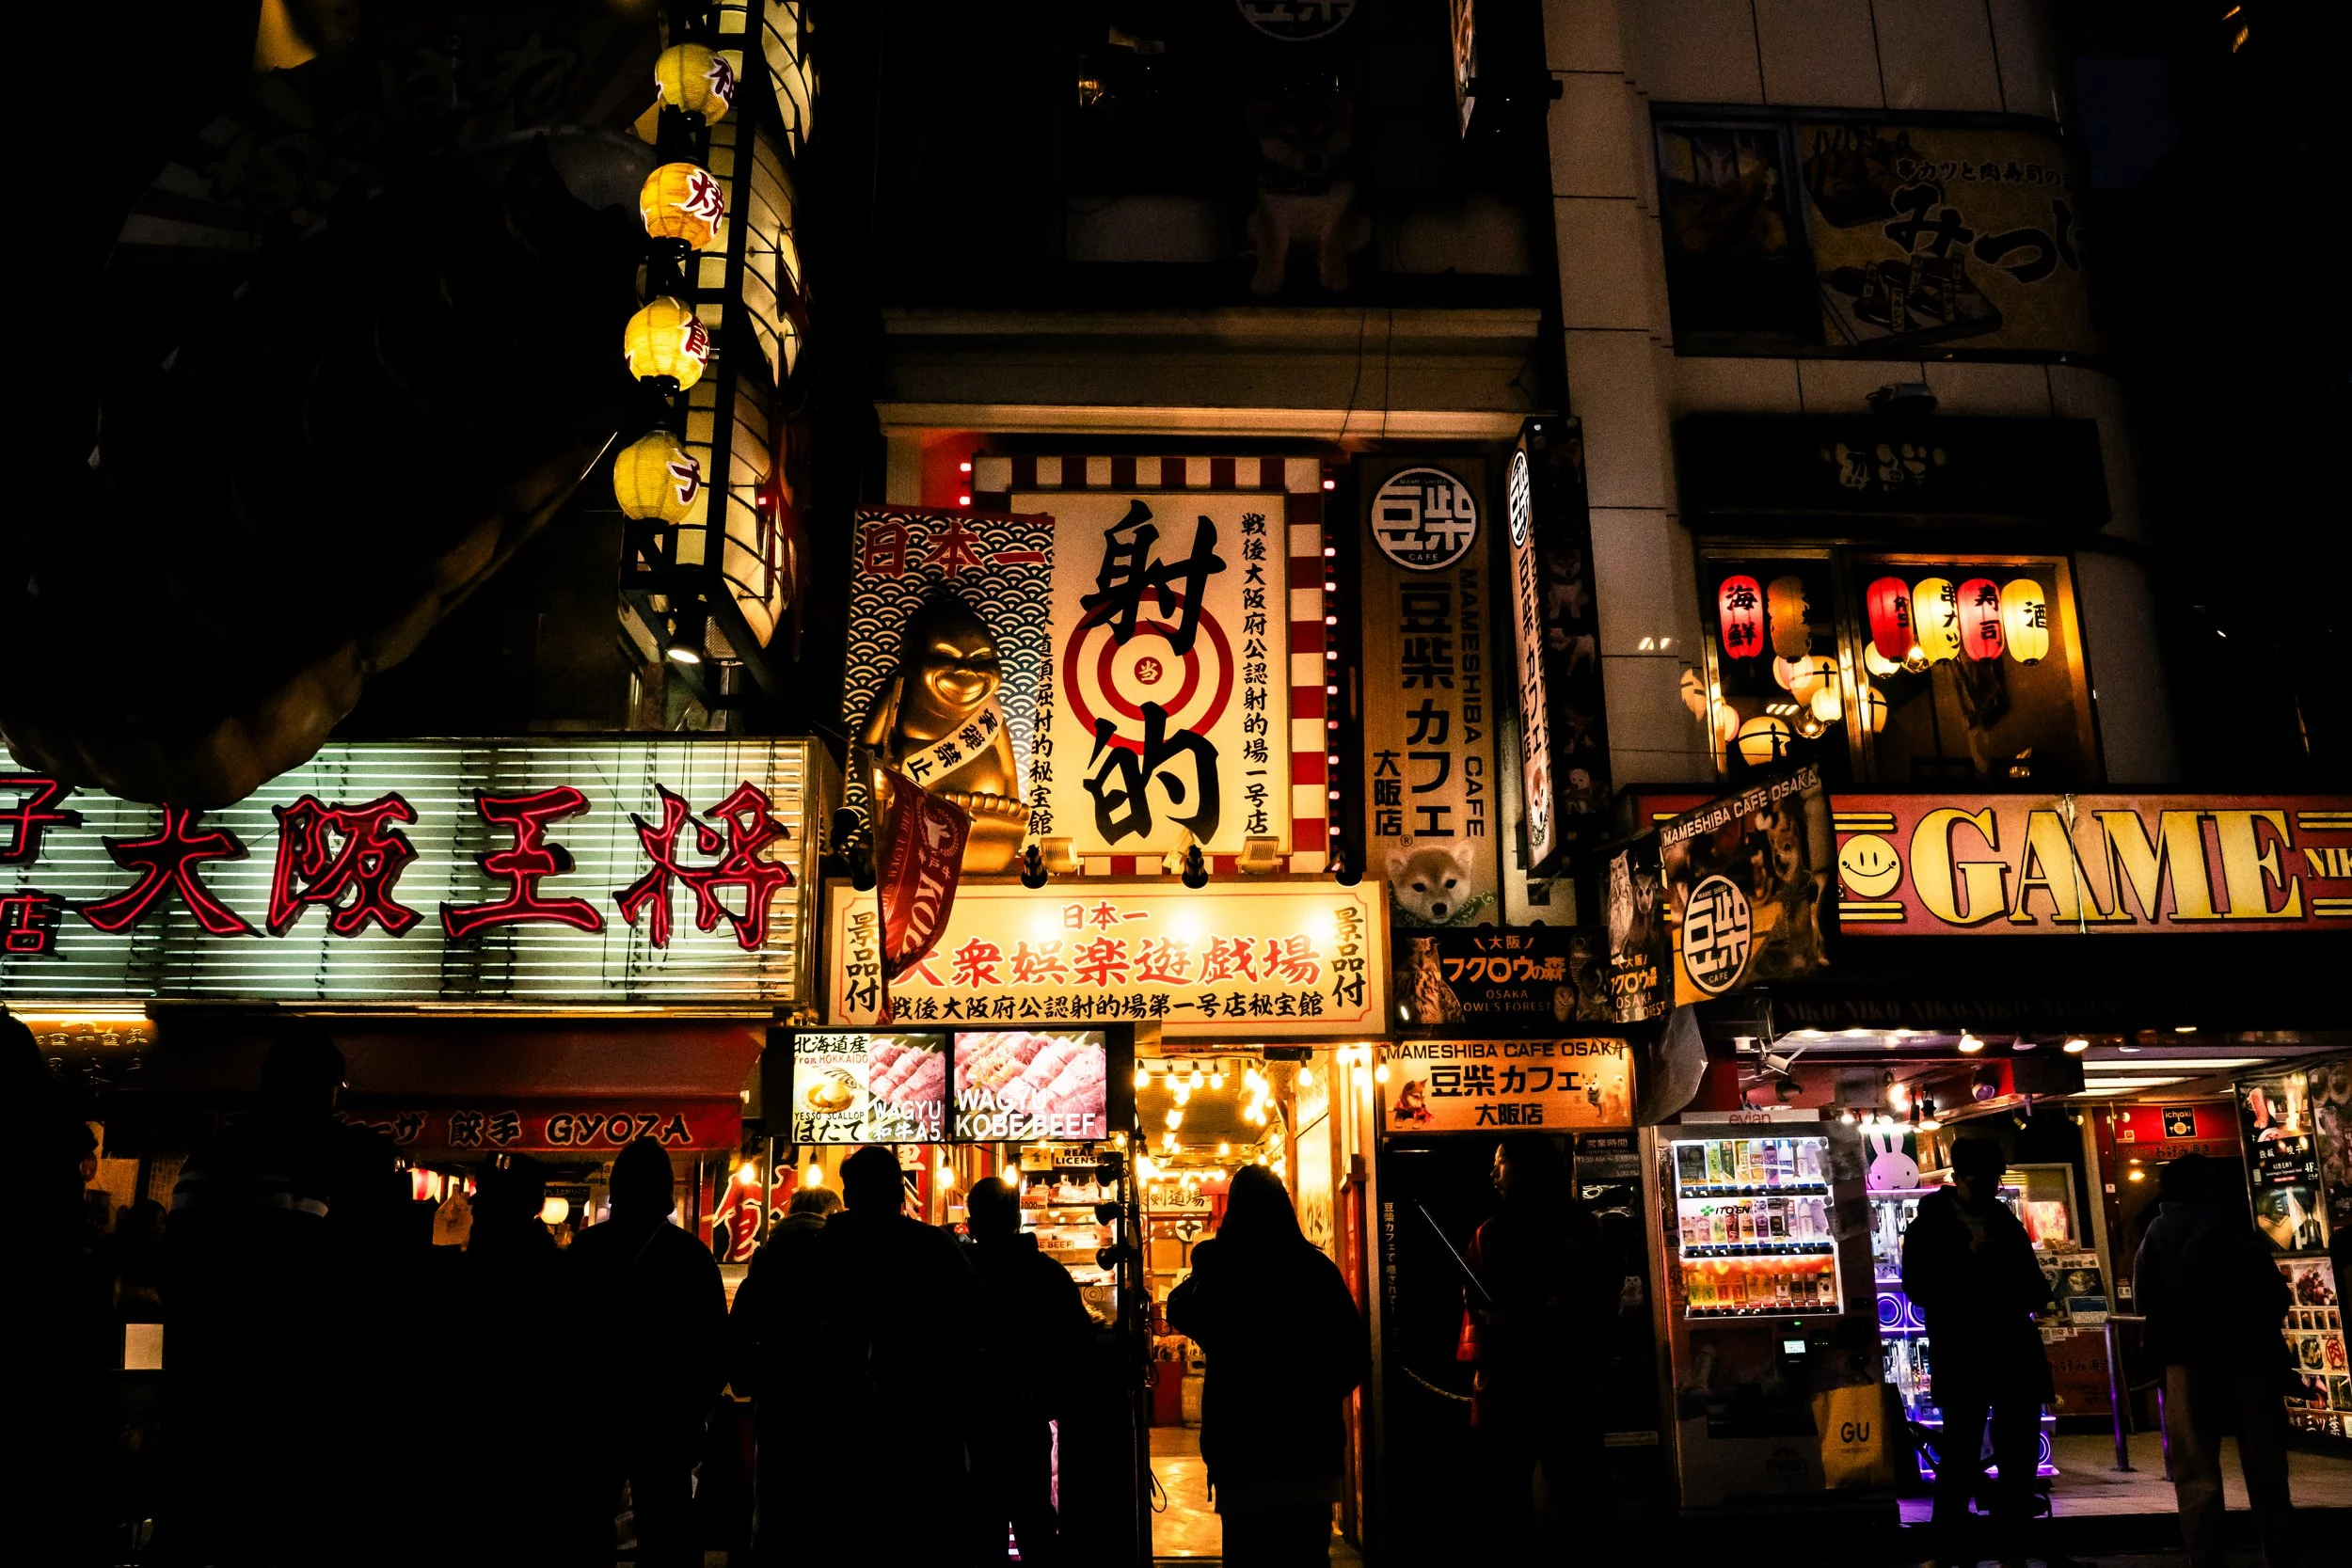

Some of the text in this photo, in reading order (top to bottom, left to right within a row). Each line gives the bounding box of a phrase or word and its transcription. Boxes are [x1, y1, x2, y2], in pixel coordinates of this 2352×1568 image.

[1884, 182, 2079, 282] みつ
[1377, 483, 1474, 552] 豆柴
[862, 522, 1047, 579] 日本一
[1408, 553, 1438, 562] CAFE
[1725, 584, 1758, 649] 海鮮
[1975, 582, 2002, 647] 寿司
[2023, 601, 2047, 628] 酒
[1079, 499, 1227, 846] 射的
[1137, 658, 1160, 684] 当
[1240, 513, 1270, 835] 戦後大阪府公認射的場一号店
[1459, 568, 1486, 838] MAMESHIBA CAFE
[905, 708, 999, 784] 実弾禁止
[1374, 749, 1403, 837] 大阪店
[1661, 768, 1818, 848] MAMESHIBA CAFE OSAKA
[68, 779, 798, 952] 大阪王将
[1910, 806, 2305, 927] GAME
[1062, 902, 1149, 931] 日本一
[1487, 935, 1521, 950] 大阪
[846, 911, 881, 1013] 景品付
[1330, 906, 1367, 1008] 景品付
[1442, 955, 1567, 984] フクロウの森
[1708, 972, 1729, 984] CAFE
[1486, 989, 1529, 1000] OSAKA
[1505, 1002, 1551, 1013] FOREST
[794, 1035, 868, 1054] 北海道産
[819, 1053, 869, 1064] HOKKAIDO
[1386, 1040, 1625, 1061] MAMESHIBA CAFE OSAKA
[873, 1100, 942, 1121] WAGYU
[956, 1086, 1048, 1112] WAGYU
[794, 1110, 866, 1121] YESSO SCALLOP
[956, 1112, 1097, 1137] KOBE BEEF
[1474, 1102, 1544, 1126] 大阪店
[1728, 1112, 1772, 1126] evian
[546, 1111, 694, 1146] GYOZA
[793, 1120, 865, 1143] ほたて
[1840, 1421, 1870, 1443] GU
